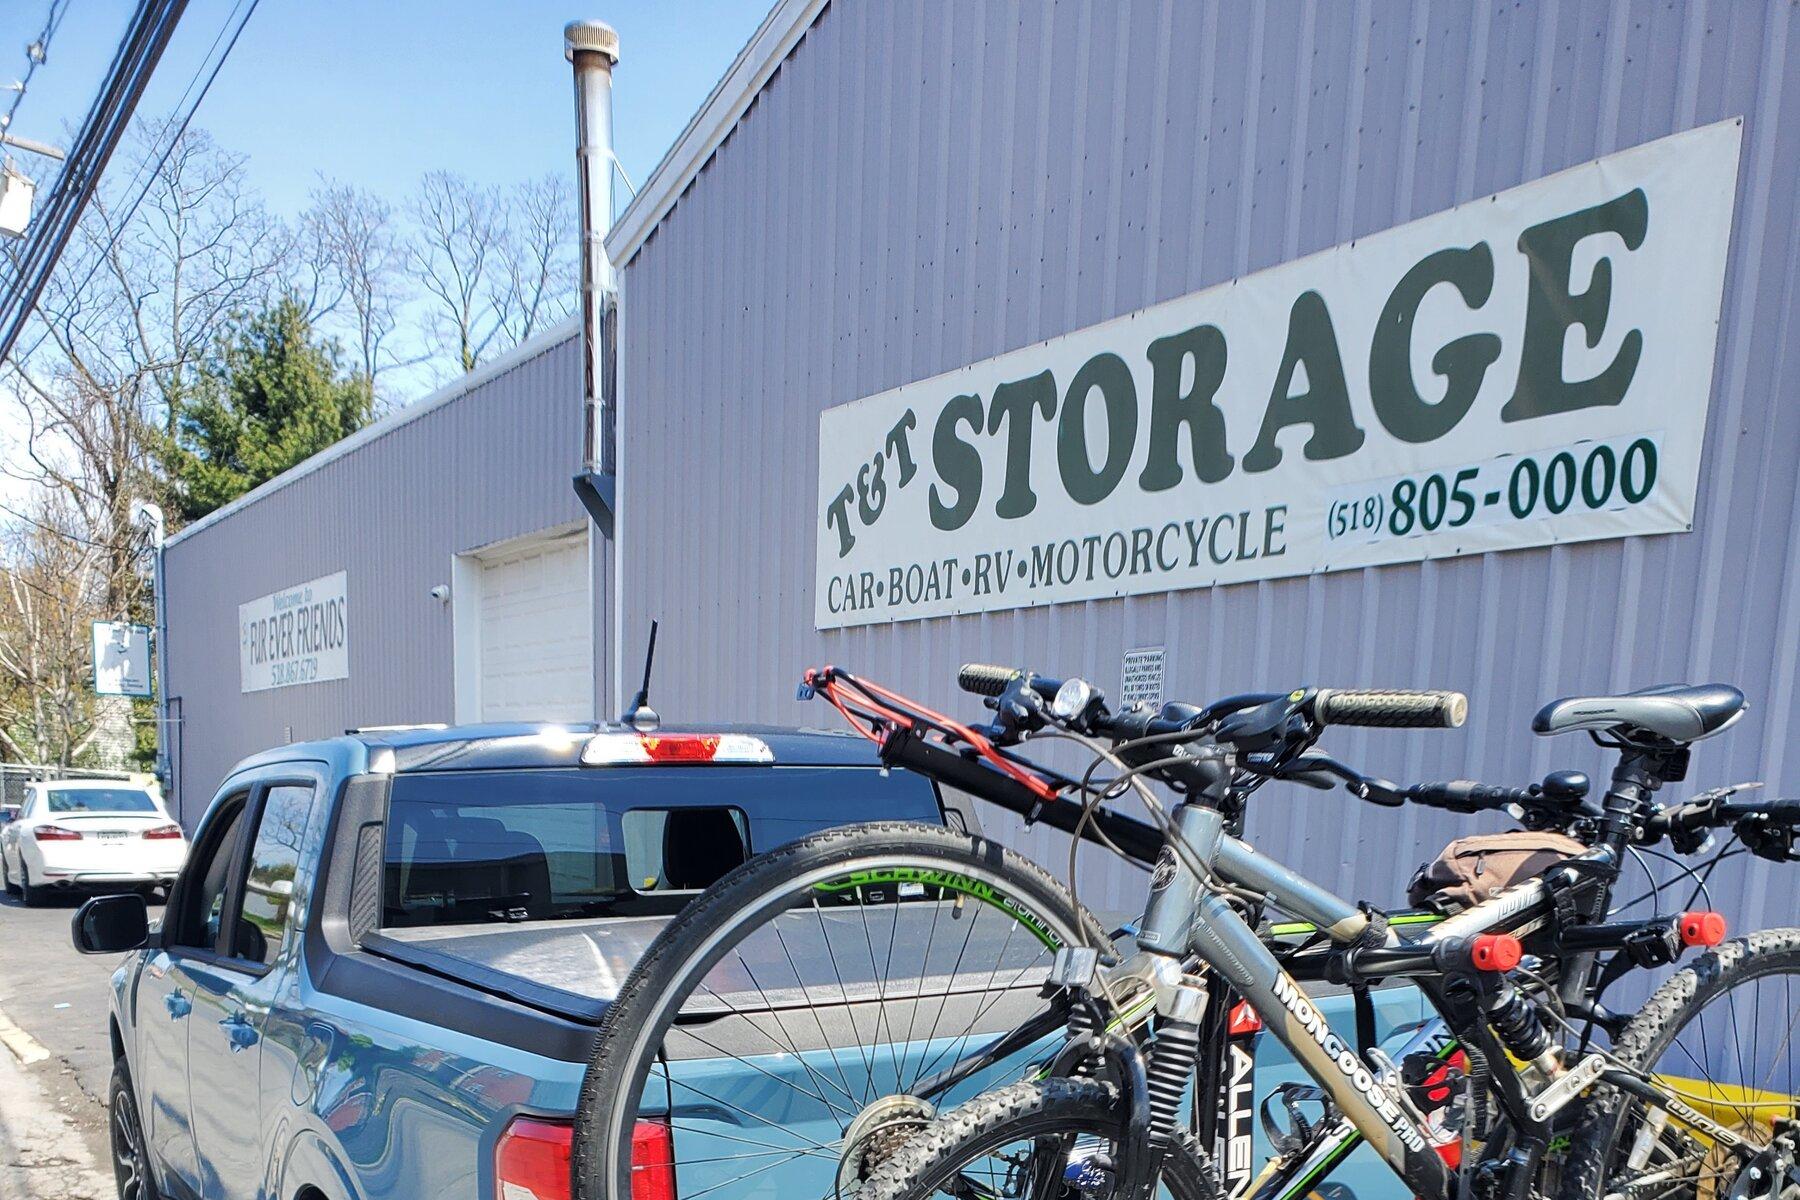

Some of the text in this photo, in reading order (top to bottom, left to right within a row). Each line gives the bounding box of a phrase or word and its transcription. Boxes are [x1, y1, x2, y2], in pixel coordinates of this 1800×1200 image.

[827, 186, 1649, 558] T&T STORAGE
[1328, 437, 1658, 540] (518) 805-0000
[1029, 505, 1288, 589] MOTORCYCLE
[250, 595, 345, 666] FUR EVER FRIENDS
[850, 867, 994, 899] SCHWINN
[1272, 971, 1425, 1153] MONGOOSE PRO
